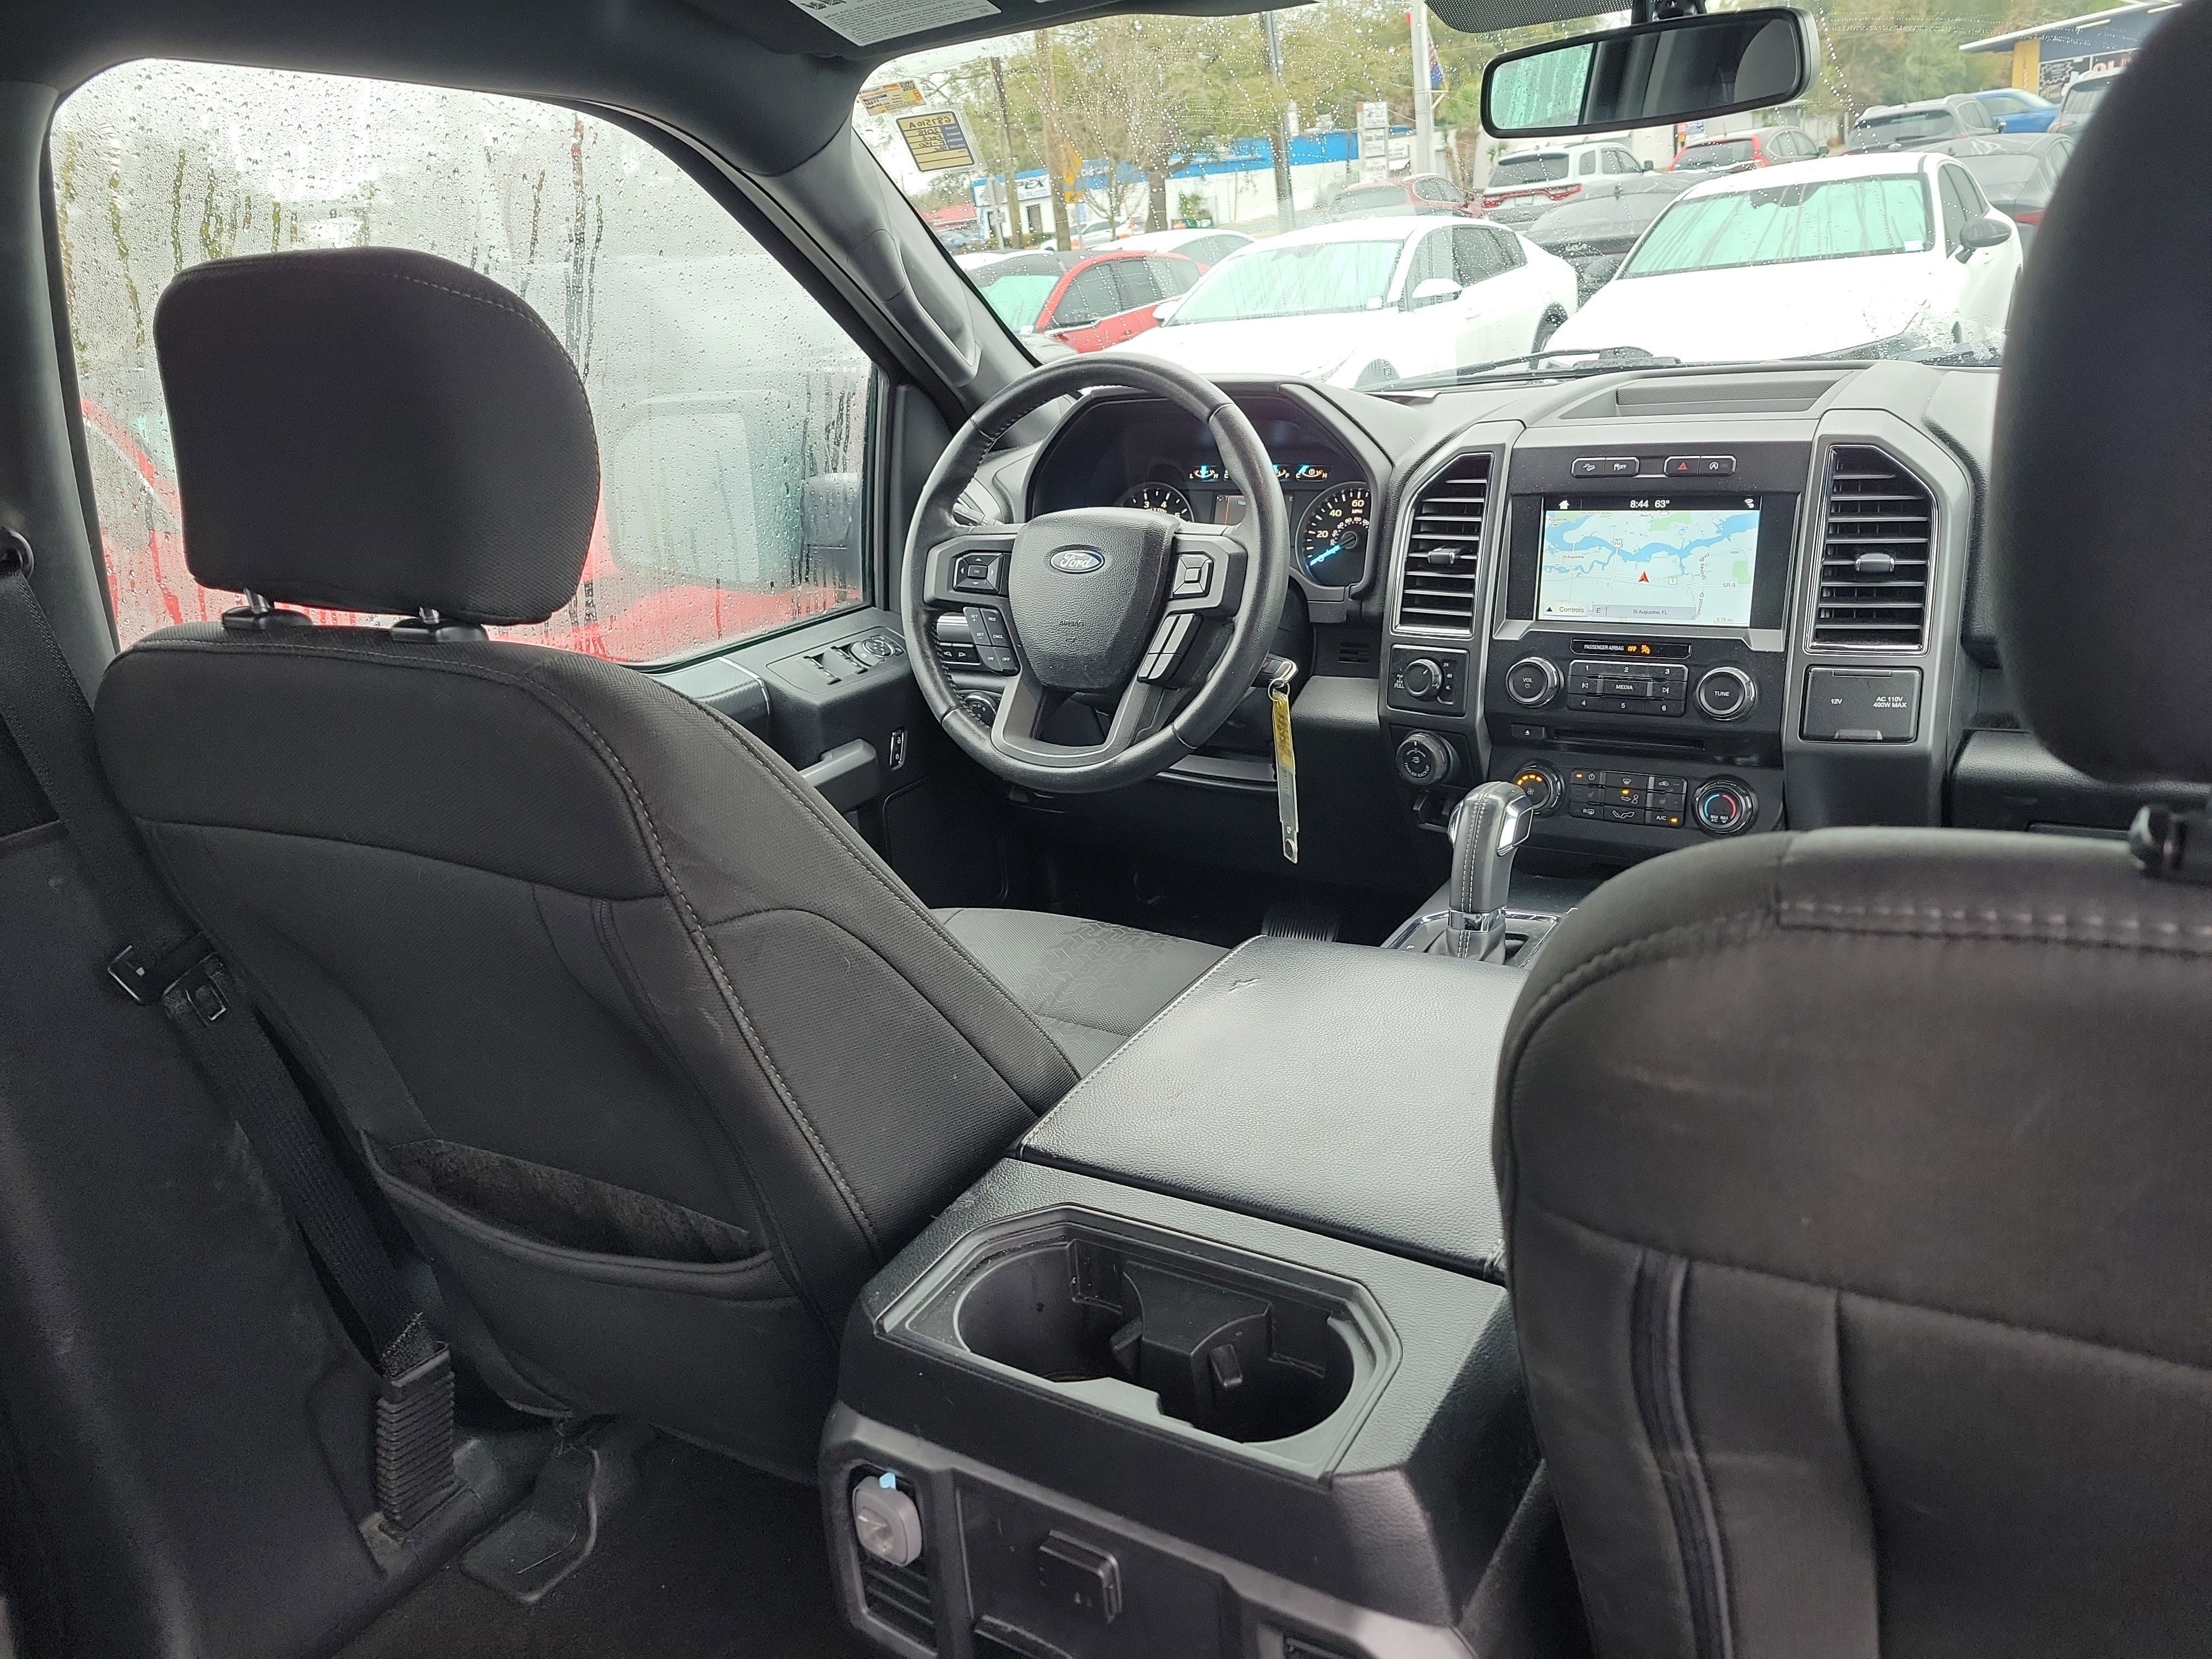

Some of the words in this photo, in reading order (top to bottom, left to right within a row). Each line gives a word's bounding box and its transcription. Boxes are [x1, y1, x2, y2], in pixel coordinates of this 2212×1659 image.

[1630, 500, 1649, 508] 8:44
[1059, 552, 1093, 568] Ford
[1404, 762, 1417, 777] TRAILER
[1417, 765, 1430, 777] BACKUP
